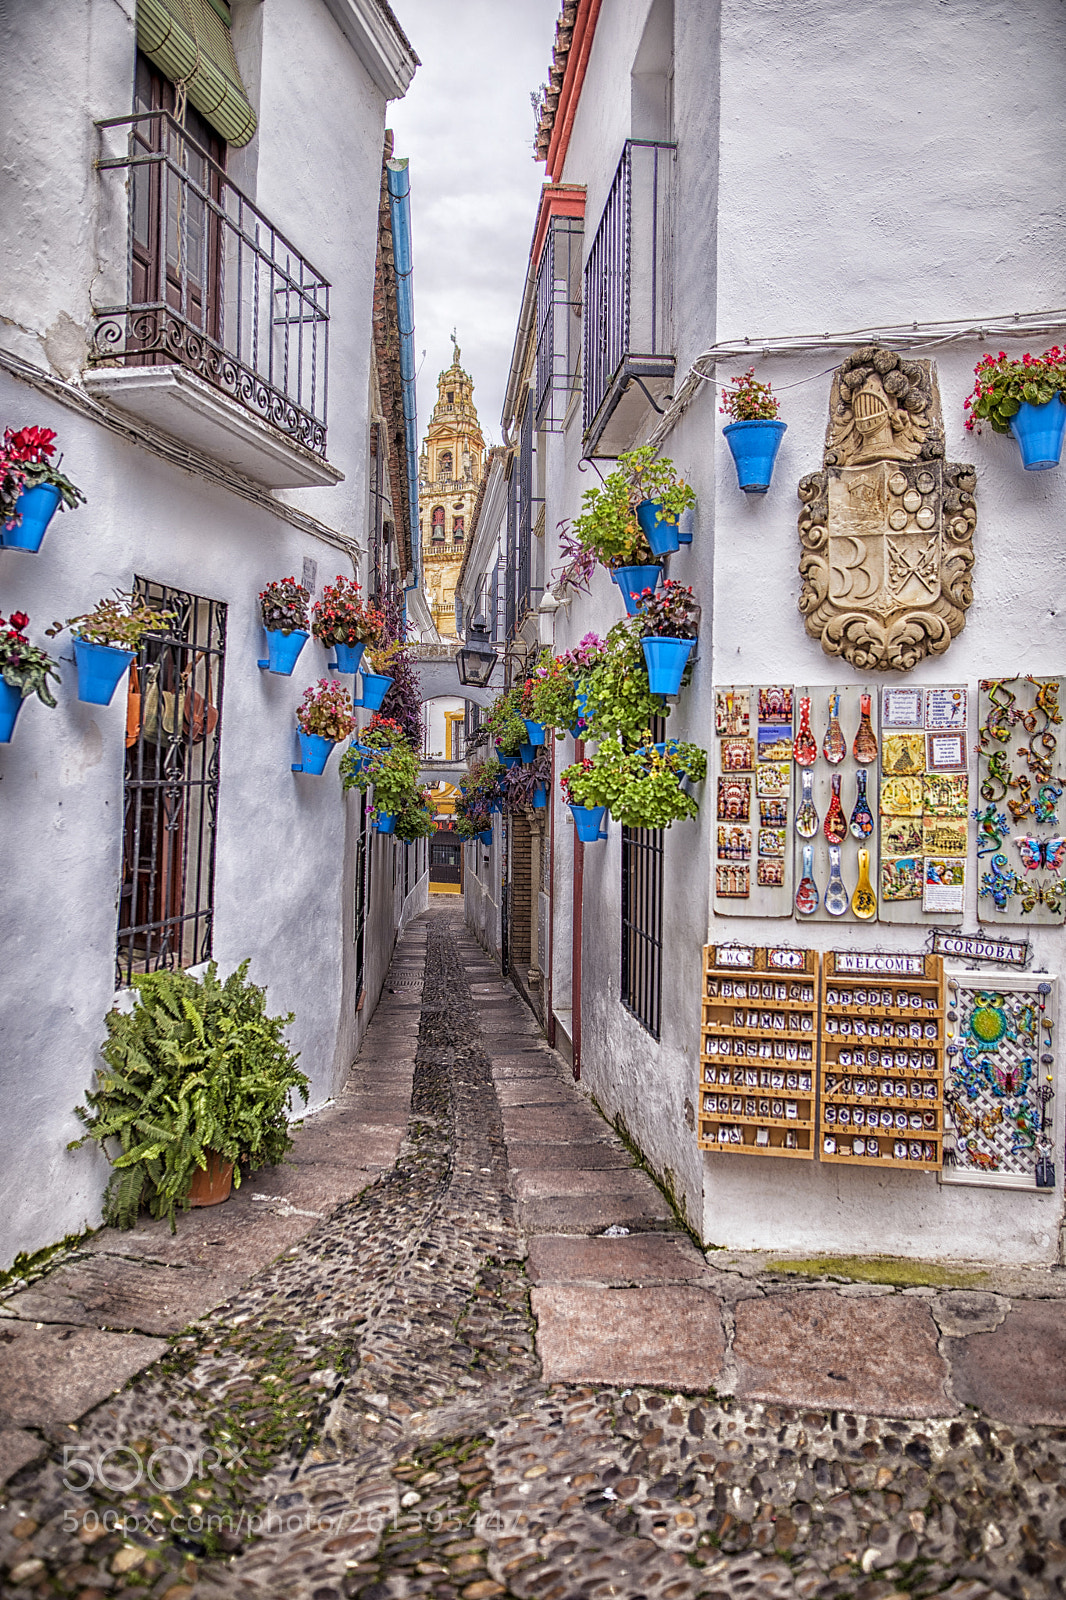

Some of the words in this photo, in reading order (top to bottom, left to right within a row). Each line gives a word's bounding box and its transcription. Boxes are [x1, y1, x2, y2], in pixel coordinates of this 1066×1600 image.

[944, 940, 1014, 959] CORDOBA
[726, 953, 744, 963] WC
[845, 957, 914, 971] WELCOME
